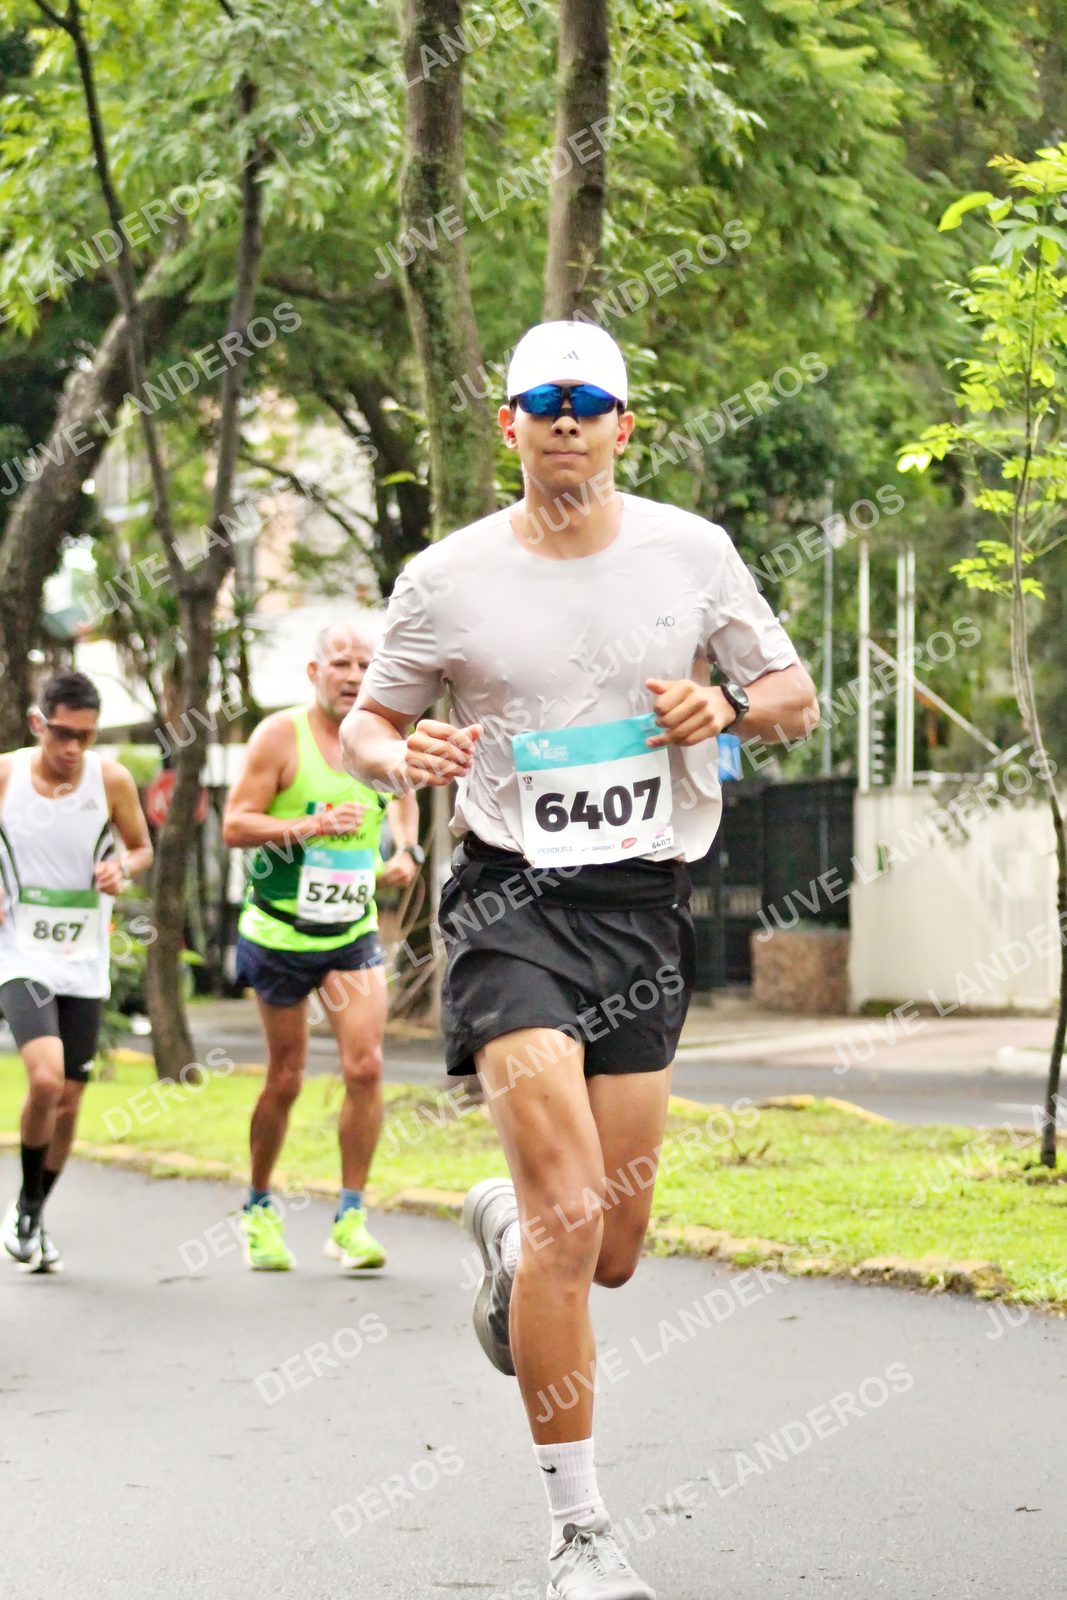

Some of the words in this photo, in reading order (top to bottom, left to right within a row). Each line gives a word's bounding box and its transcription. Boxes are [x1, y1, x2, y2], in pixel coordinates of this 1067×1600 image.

[535, 776, 661, 832] 6407
[652, 837, 671, 849] 6407
[306, 882, 368, 904] 5248
[33, 920, 83, 942] 867
